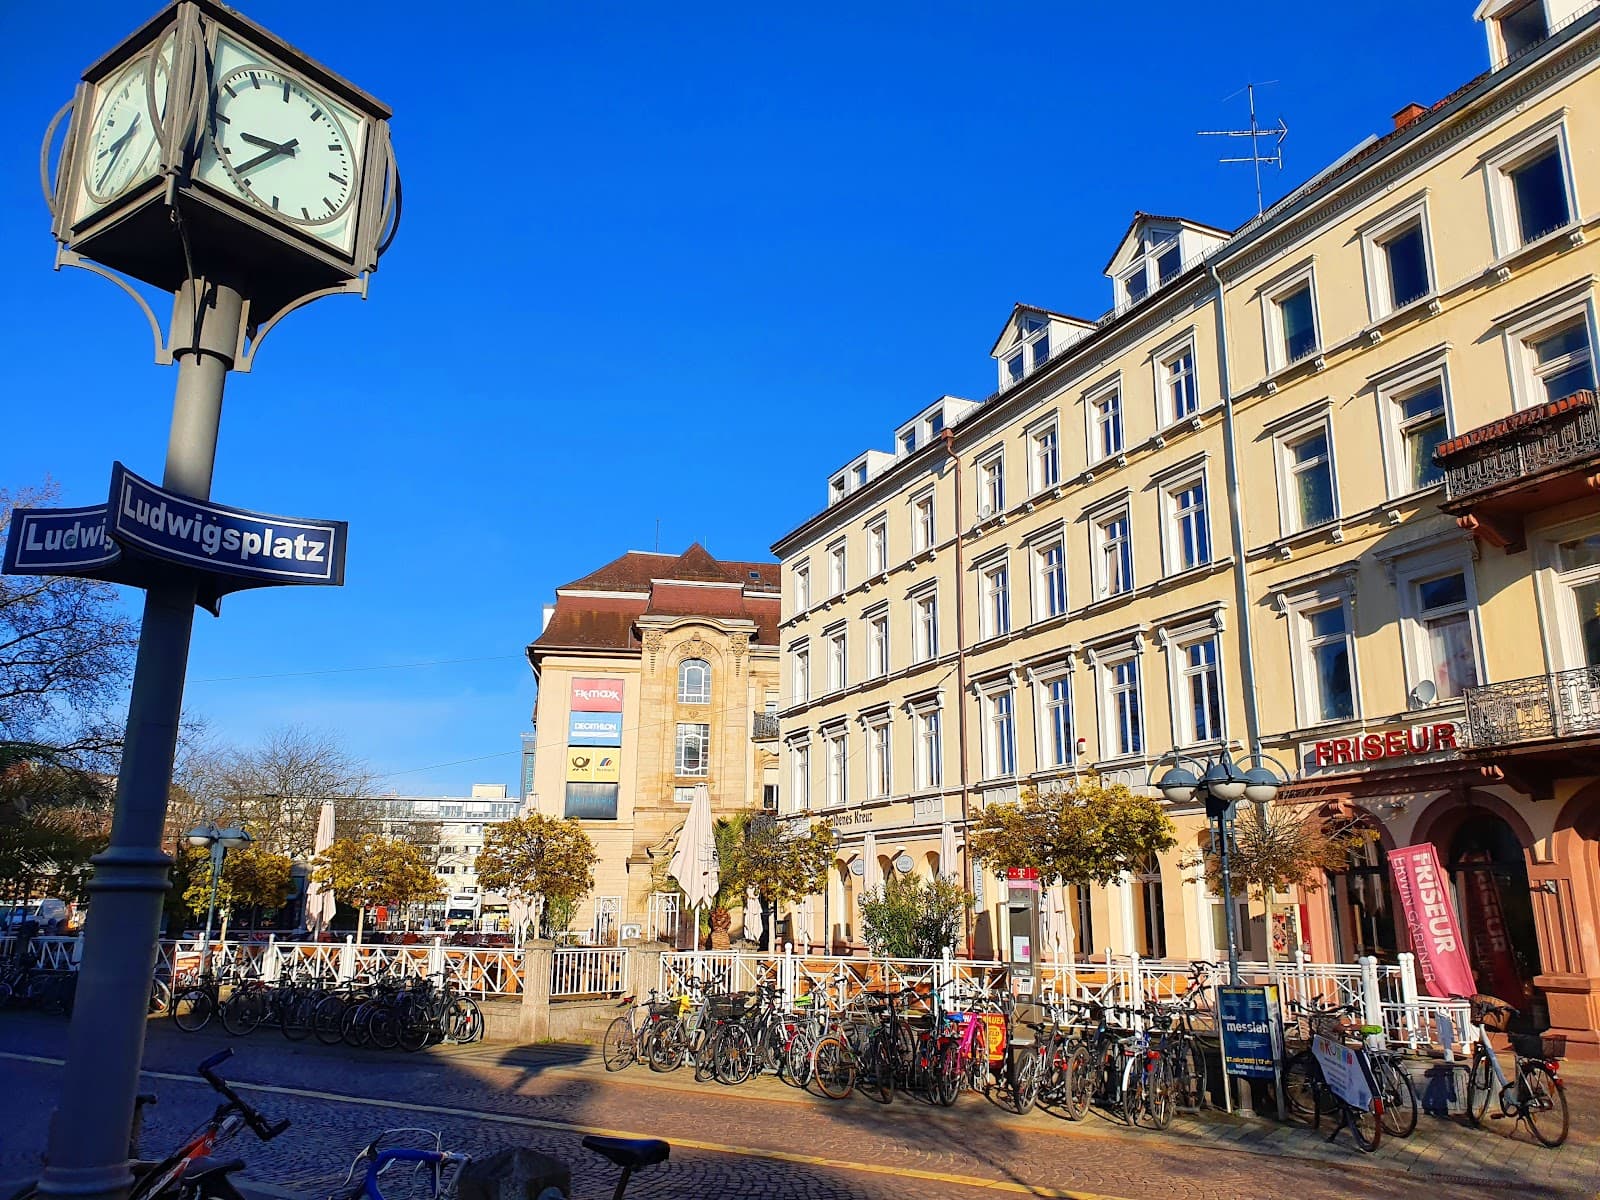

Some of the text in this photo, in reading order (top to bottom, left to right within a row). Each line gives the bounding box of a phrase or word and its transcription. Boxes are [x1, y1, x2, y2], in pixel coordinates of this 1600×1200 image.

[123, 484, 325, 562] Ludwigsplatz
[1315, 723, 1457, 767] FRISEUR
[1393, 856, 1416, 906] ERWIN
[1412, 852, 1456, 955] FRISEUR
[1408, 911, 1436, 983] GÄRTNER
[1226, 1021, 1269, 1033] messiah
